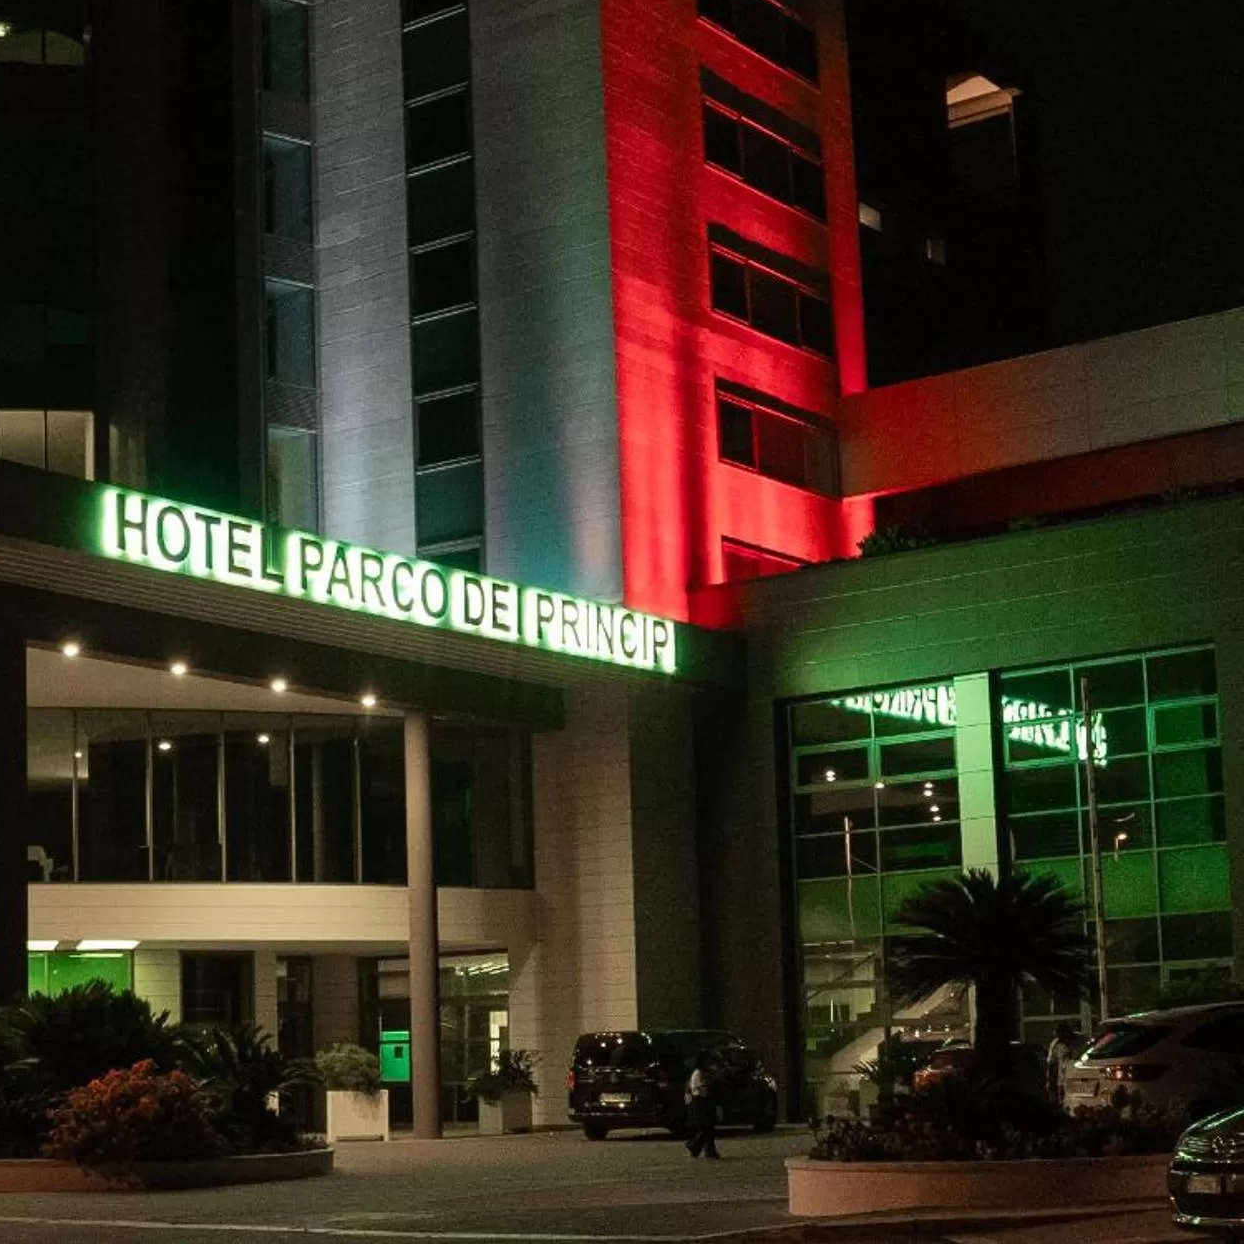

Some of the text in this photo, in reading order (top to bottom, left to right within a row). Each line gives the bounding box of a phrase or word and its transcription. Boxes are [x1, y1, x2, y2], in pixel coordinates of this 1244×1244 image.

[116, 493, 285, 584] HOTEL
[299, 537, 449, 619] PARCO
[464, 576, 523, 637] DEI
